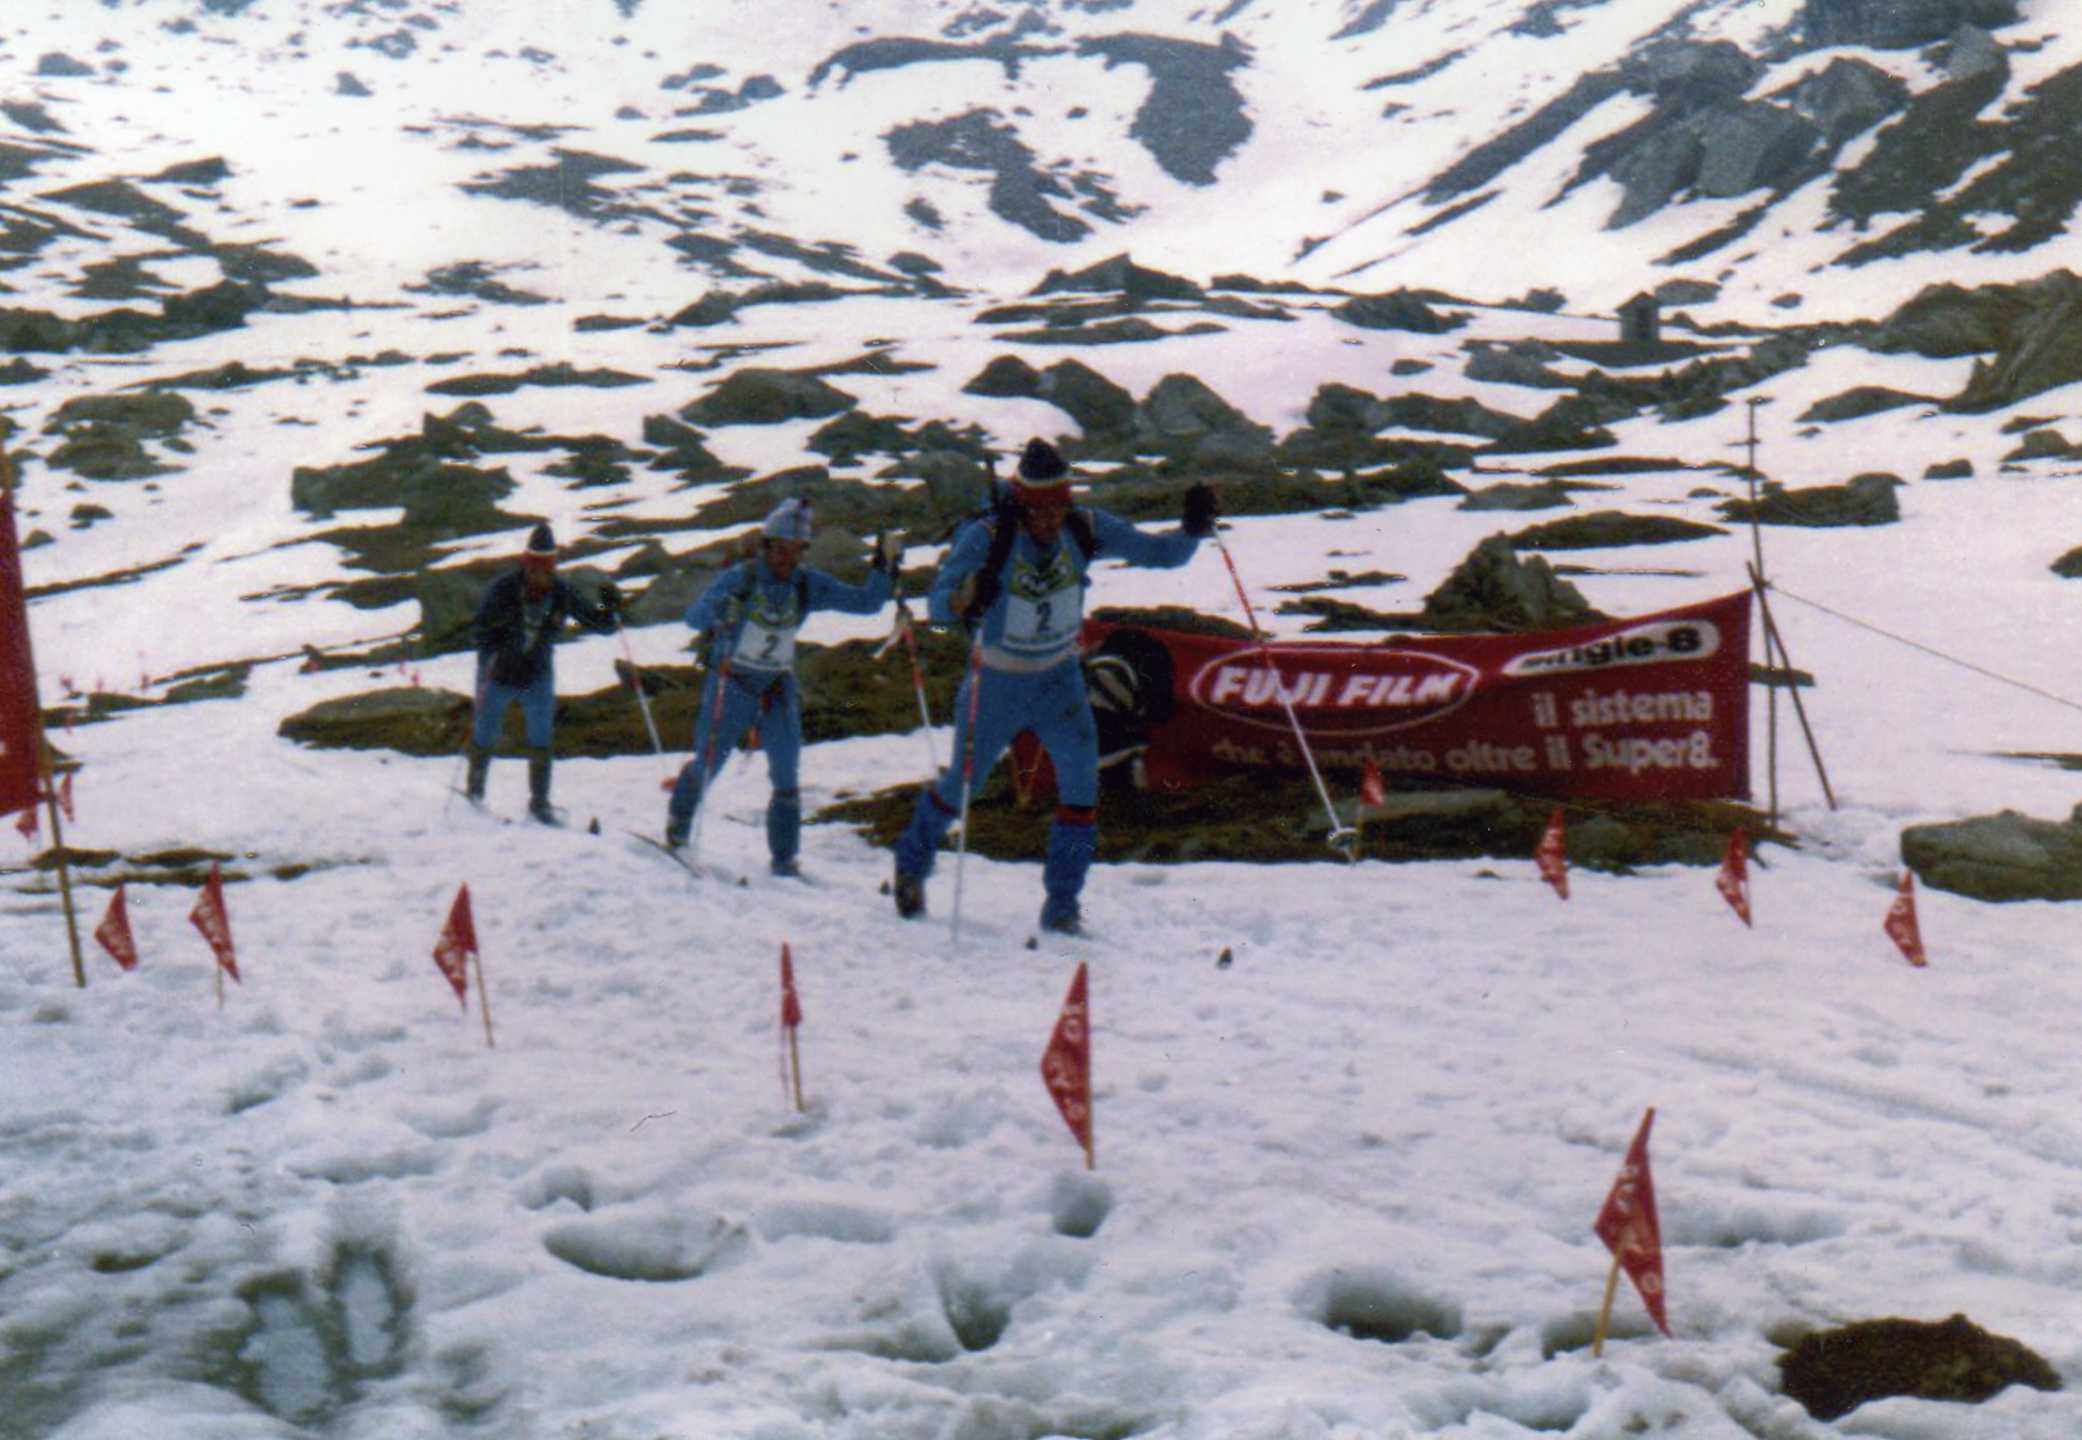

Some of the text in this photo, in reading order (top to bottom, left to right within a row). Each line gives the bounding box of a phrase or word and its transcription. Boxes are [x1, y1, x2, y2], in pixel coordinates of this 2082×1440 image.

[1036, 601, 1052, 633] 2
[1211, 666, 1461, 706] FUJI FILM
[1531, 688, 1714, 728] il sistema
[1445, 738, 1537, 771] oltre
